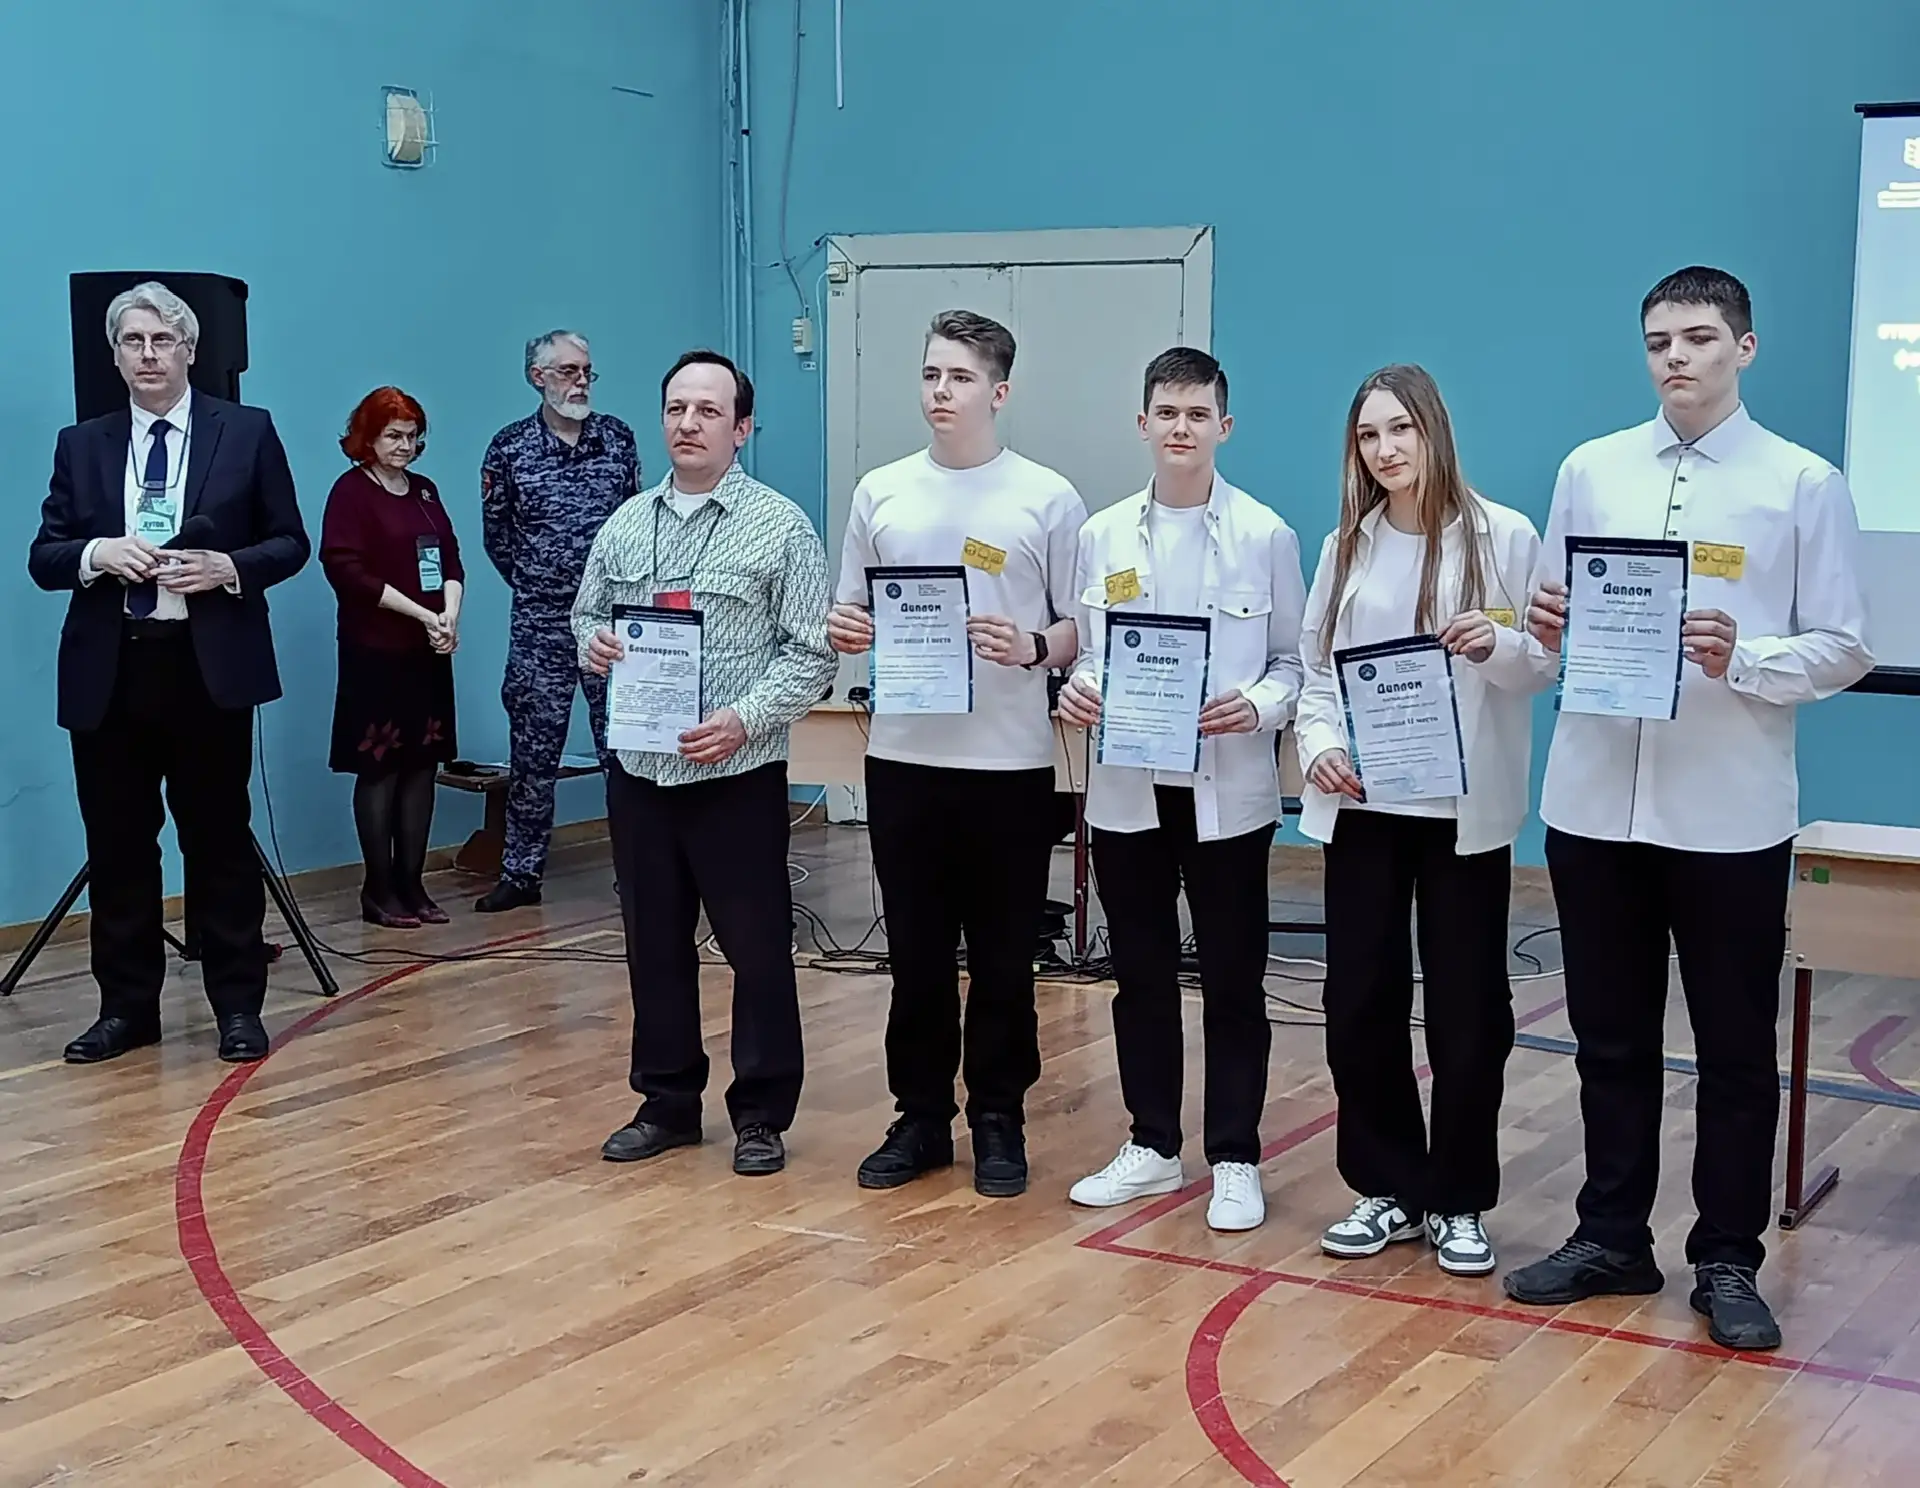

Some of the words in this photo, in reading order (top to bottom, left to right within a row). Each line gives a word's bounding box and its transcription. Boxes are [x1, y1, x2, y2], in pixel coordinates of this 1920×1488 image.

[1602, 582, 1652, 597] Диплом
[900, 602, 942, 613] Диплом
[1136, 652, 1180, 666] Диплом
[1376, 680, 1423, 695] Диплом
